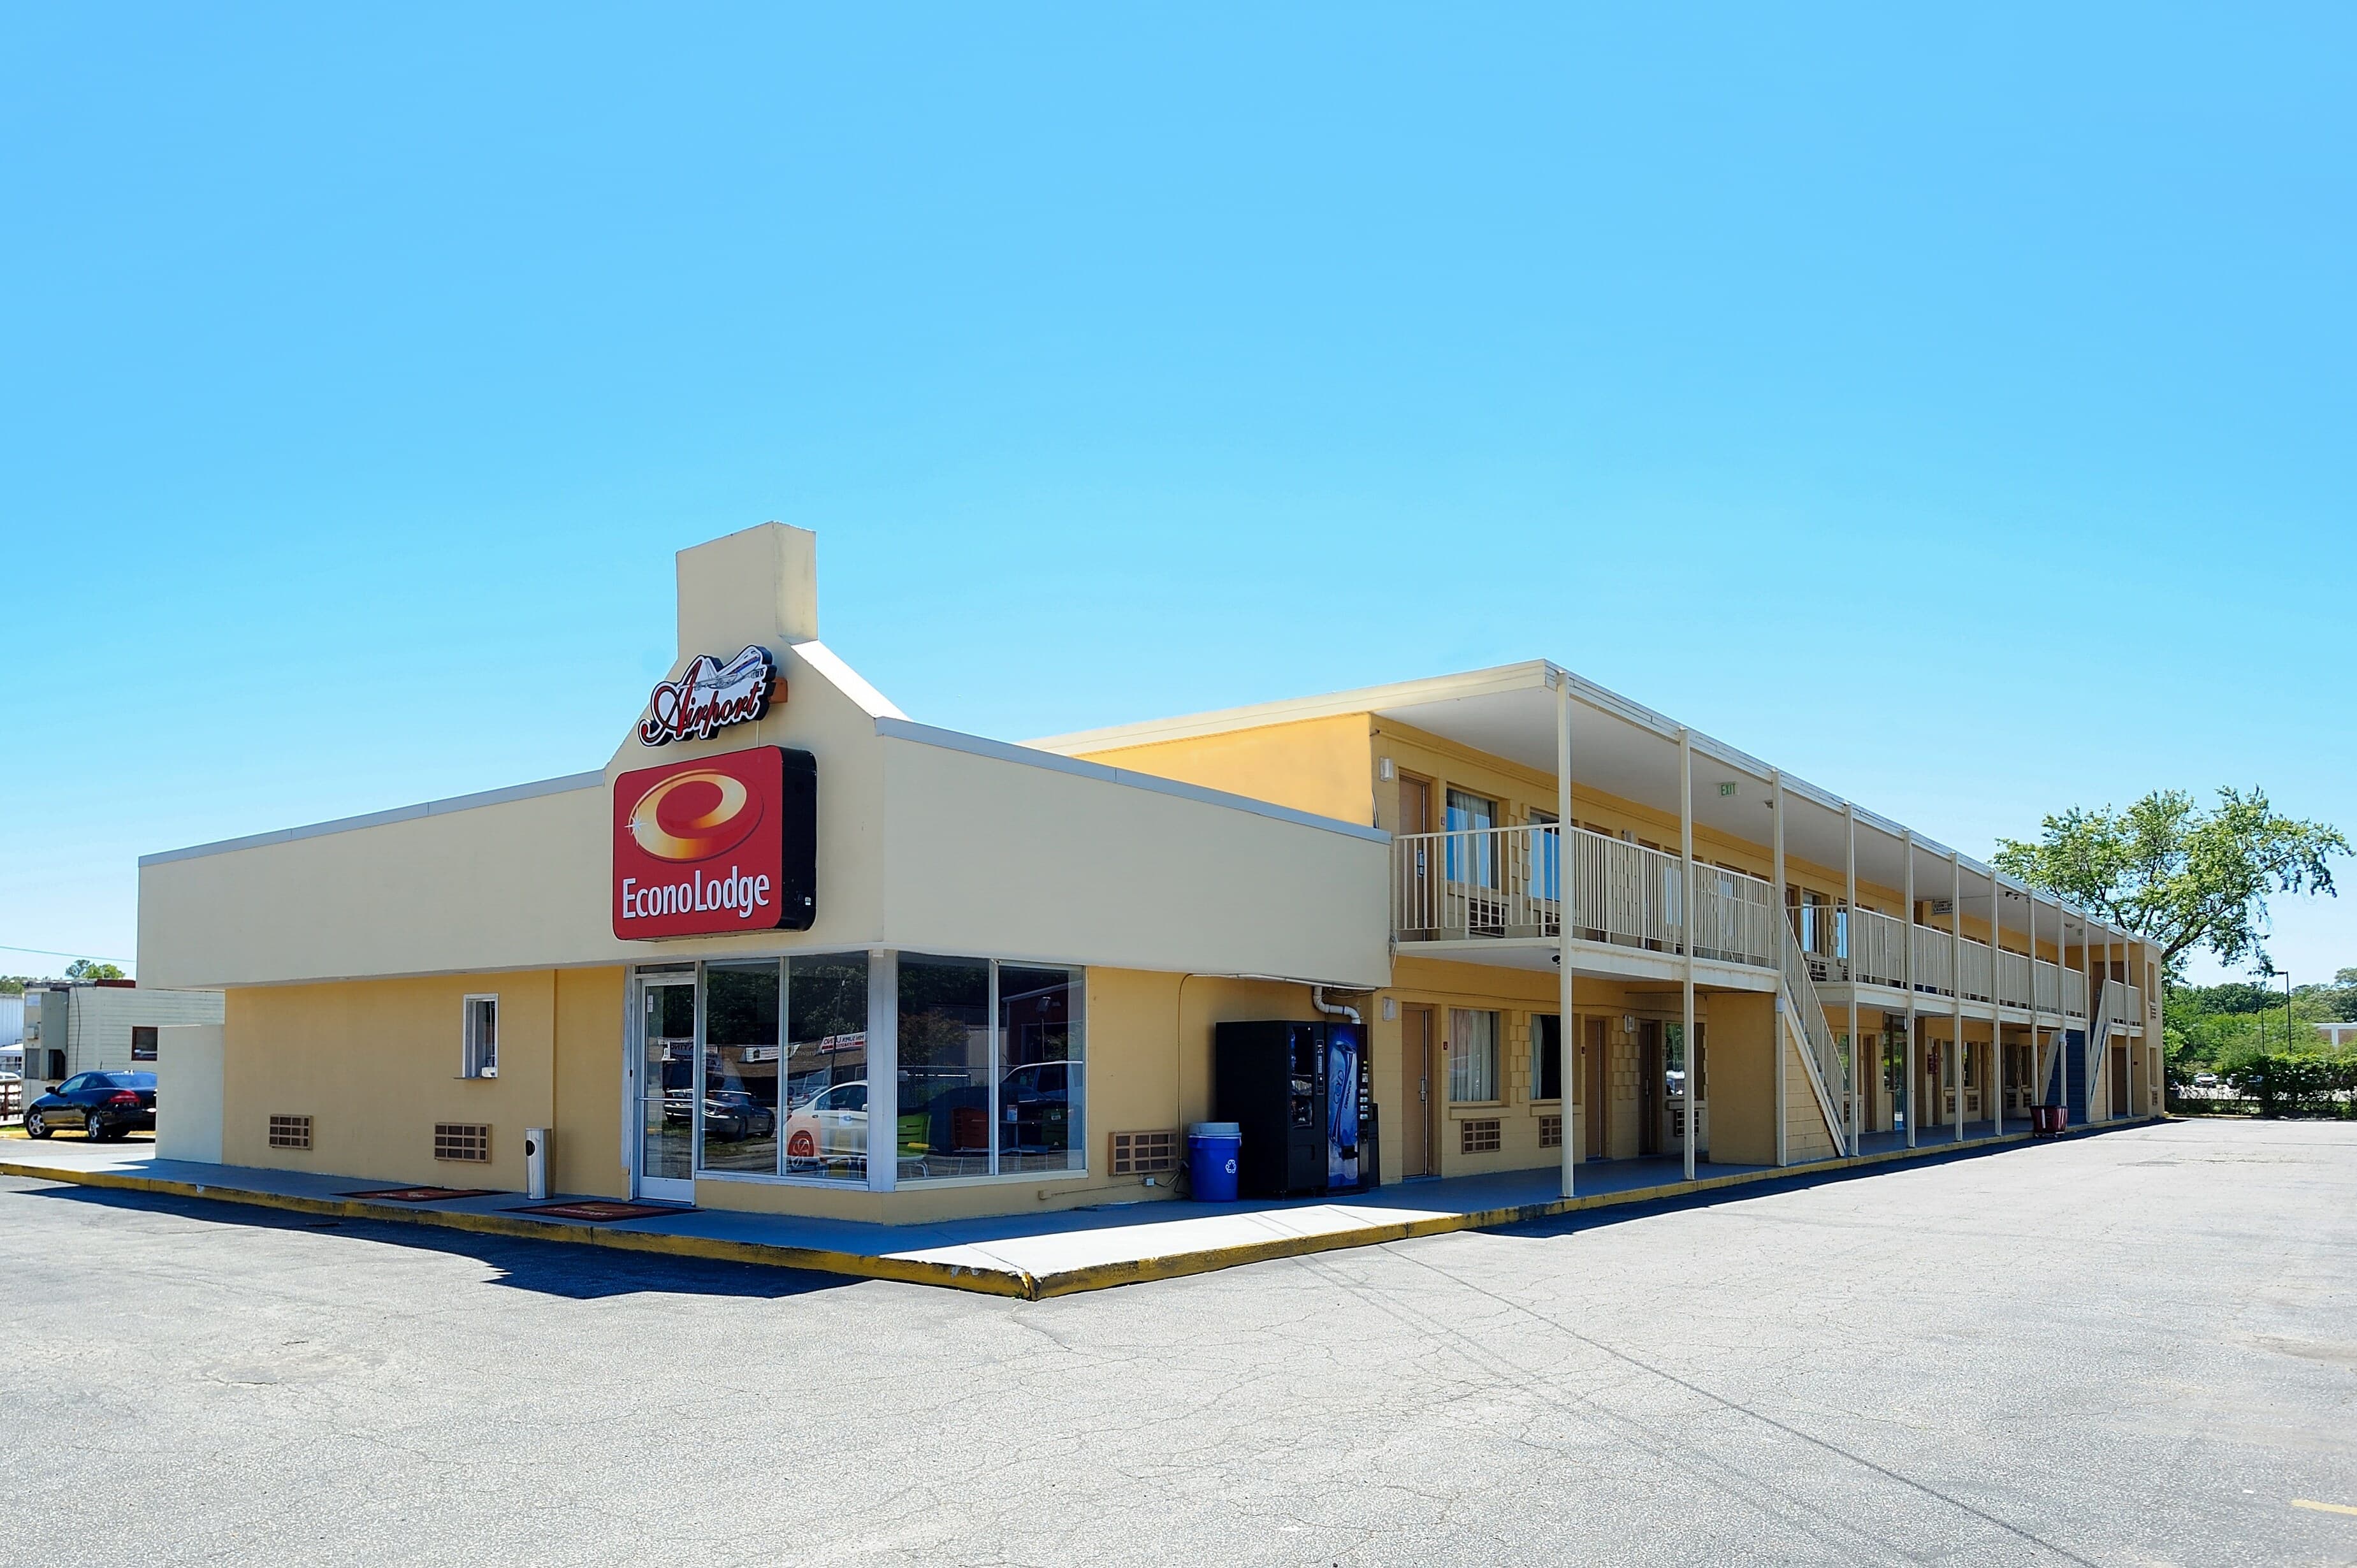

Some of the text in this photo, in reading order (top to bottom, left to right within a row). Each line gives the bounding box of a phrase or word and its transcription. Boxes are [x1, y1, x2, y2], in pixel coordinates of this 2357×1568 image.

[641, 657, 763, 742] Airport
[1721, 783, 1736, 795] EXIT
[622, 865, 770, 920] EconoLodge
